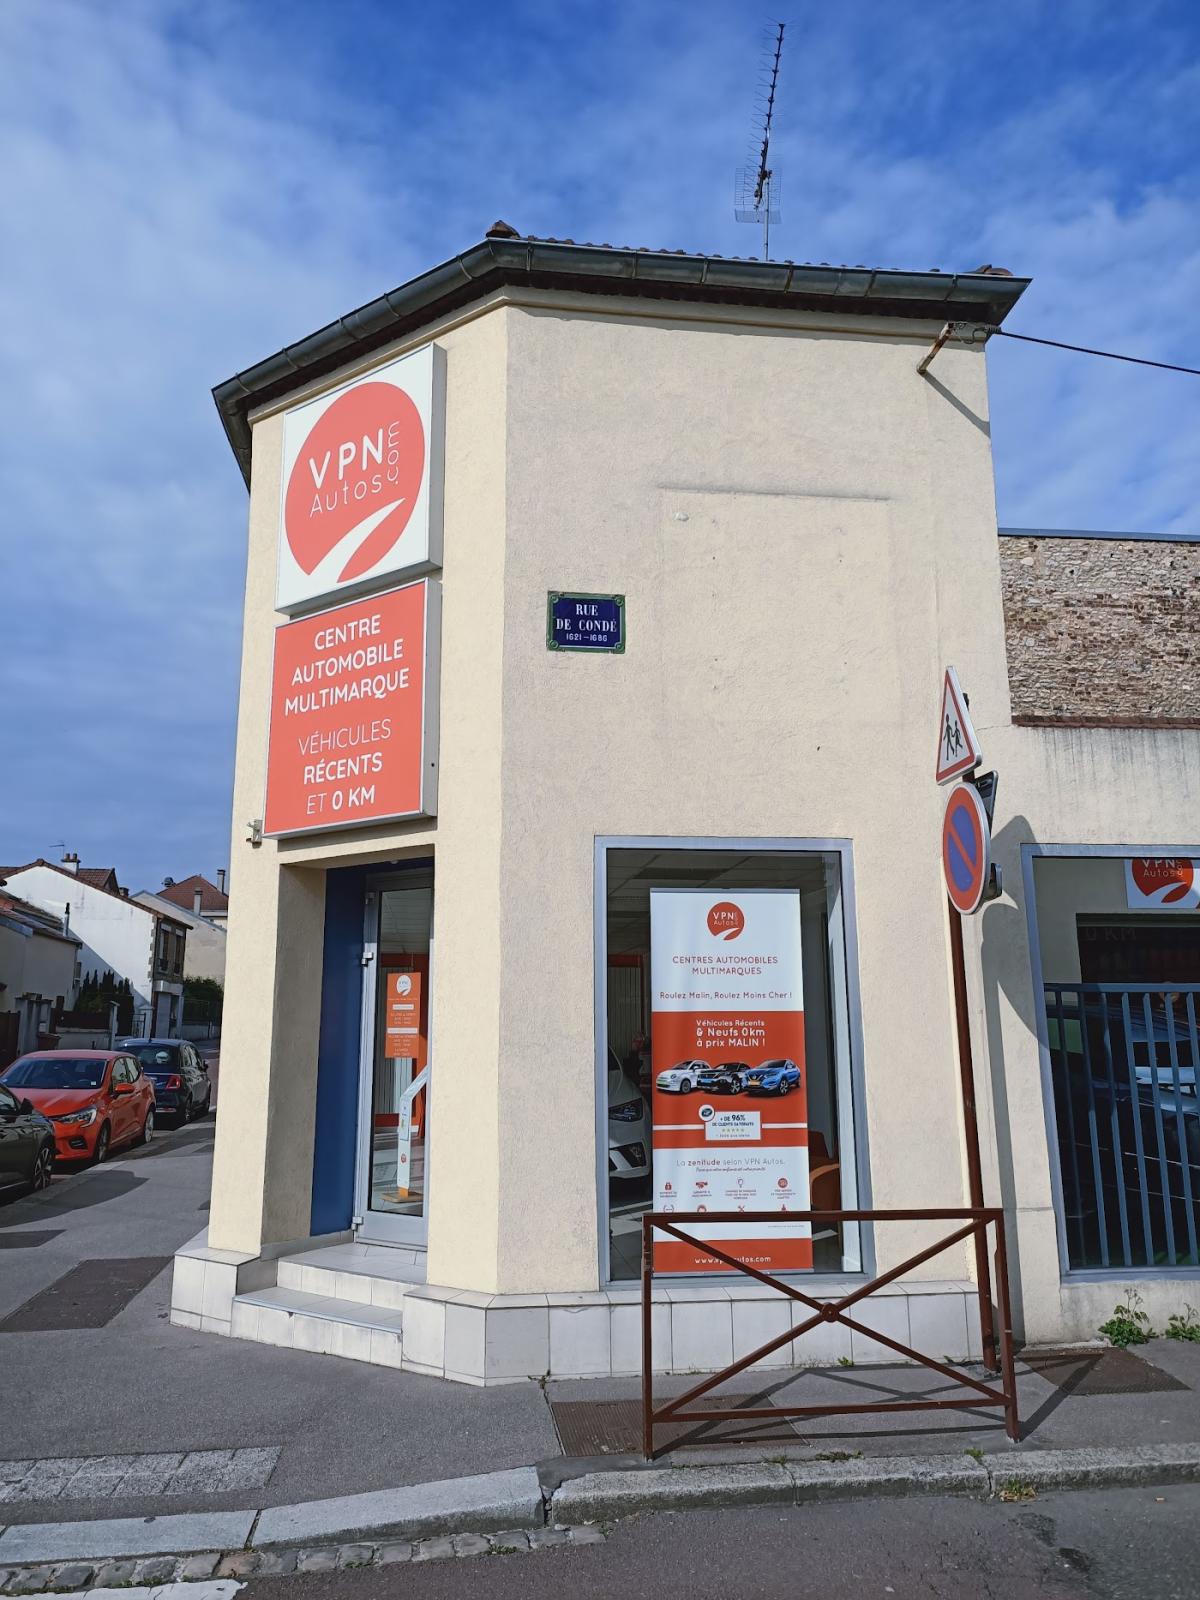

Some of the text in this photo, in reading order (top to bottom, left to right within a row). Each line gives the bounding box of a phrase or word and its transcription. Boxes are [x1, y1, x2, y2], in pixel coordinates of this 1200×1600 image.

[309, 428, 383, 489] VPN
[310, 475, 382, 518] Autos
[575, 604, 599, 616] RUE
[556, 618, 617, 632] DE CONDÉ
[314, 614, 382, 650] CENTRE
[291, 638, 404, 686] AUTOMOBILE
[284, 668, 410, 716] MULTIMARQUE
[298, 718, 392, 756] VÉHICULES
[303, 752, 384, 785] RÉCENTS
[306, 785, 376, 815] ET 0 KM
[1143, 868, 1176, 877] Autos
[712, 911, 734, 920] VPN
[672, 956, 779, 964] CENTRES AUTOMOBILES
[692, 967, 762, 976] MULTIMARQUES
[659, 991, 686, 999] Roulez
[689, 991, 713, 1000] Malin,
[714, 991, 740, 999] Roulez
[743, 991, 766, 999] Moins
[768, 991, 787, 999] Cher
[696, 1019, 765, 1027] Véhicules Récents
[696, 1027, 704, 1037] &
[707, 1027, 739, 1037] Neufs
[696, 1038, 703, 1047] à
[705, 1038, 725, 1049] prix
[728, 1038, 759, 1047] MALIN
